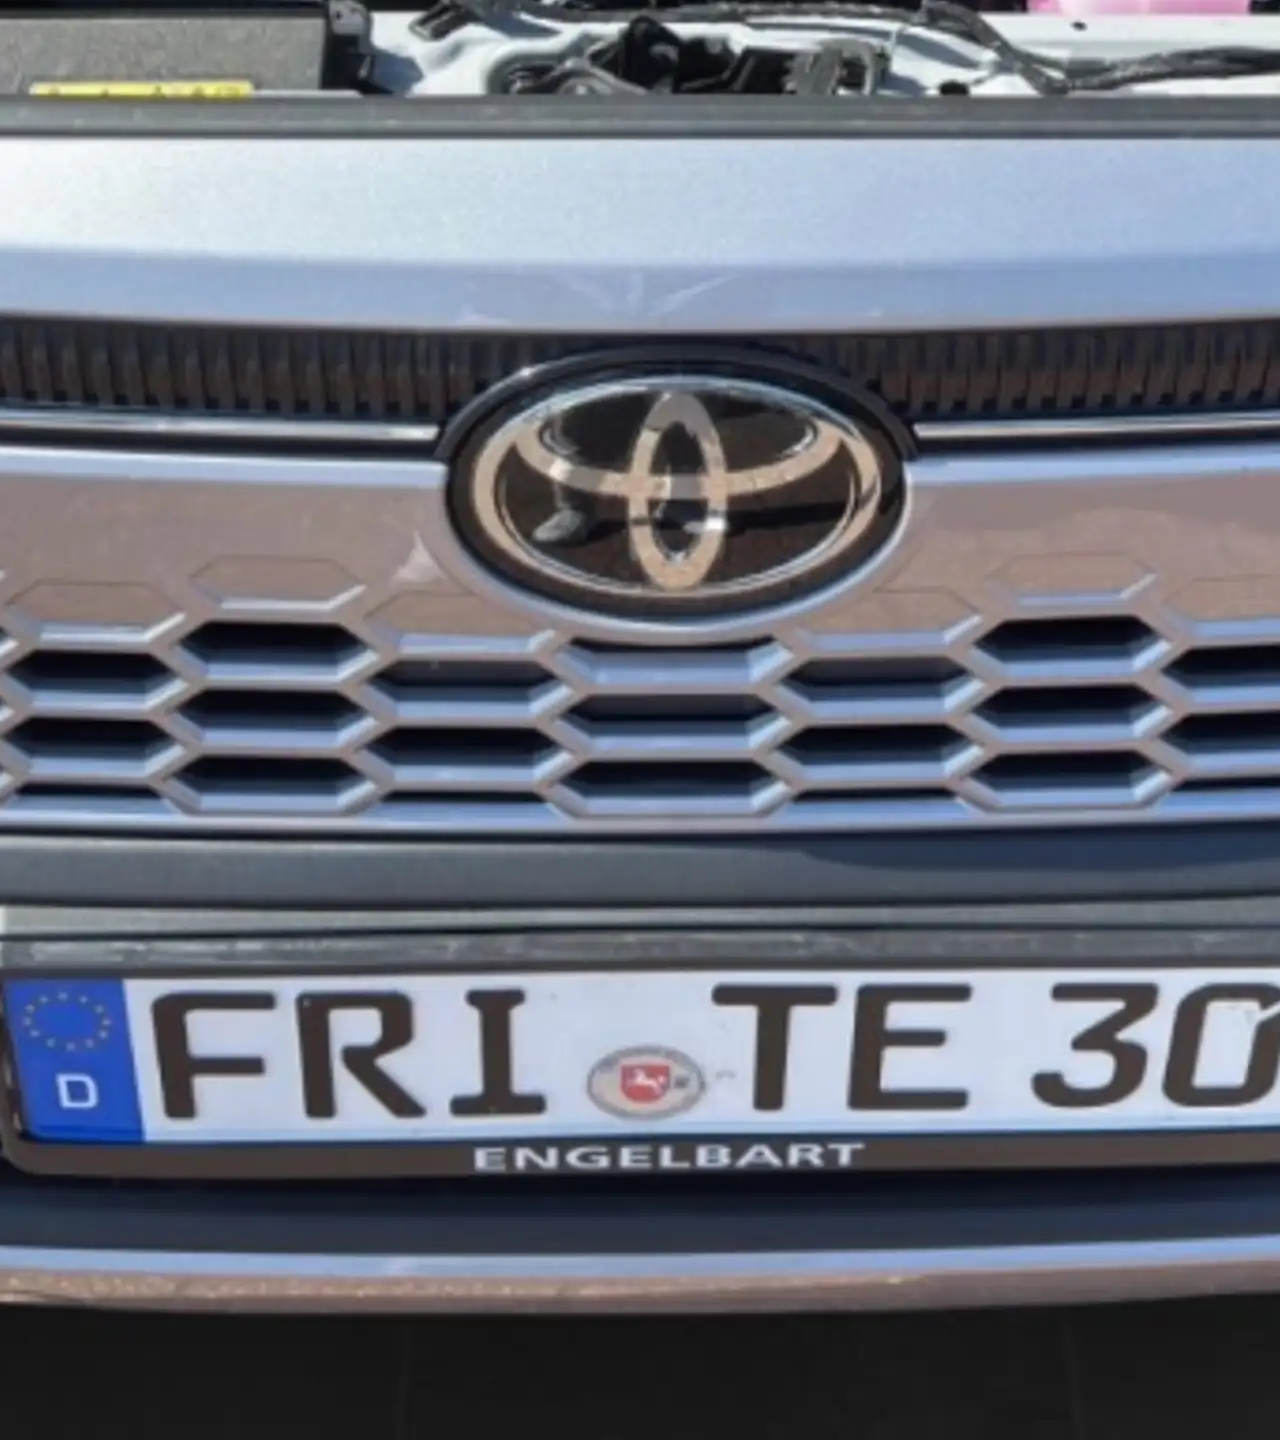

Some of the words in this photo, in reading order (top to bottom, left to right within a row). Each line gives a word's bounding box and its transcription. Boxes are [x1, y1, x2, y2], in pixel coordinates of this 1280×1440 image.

[150, 987, 548, 1120] FRI
[710, 982, 973, 1112] TE
[56, 1073, 98, 1109] D
[472, 1142, 866, 1171] ENGELBART
